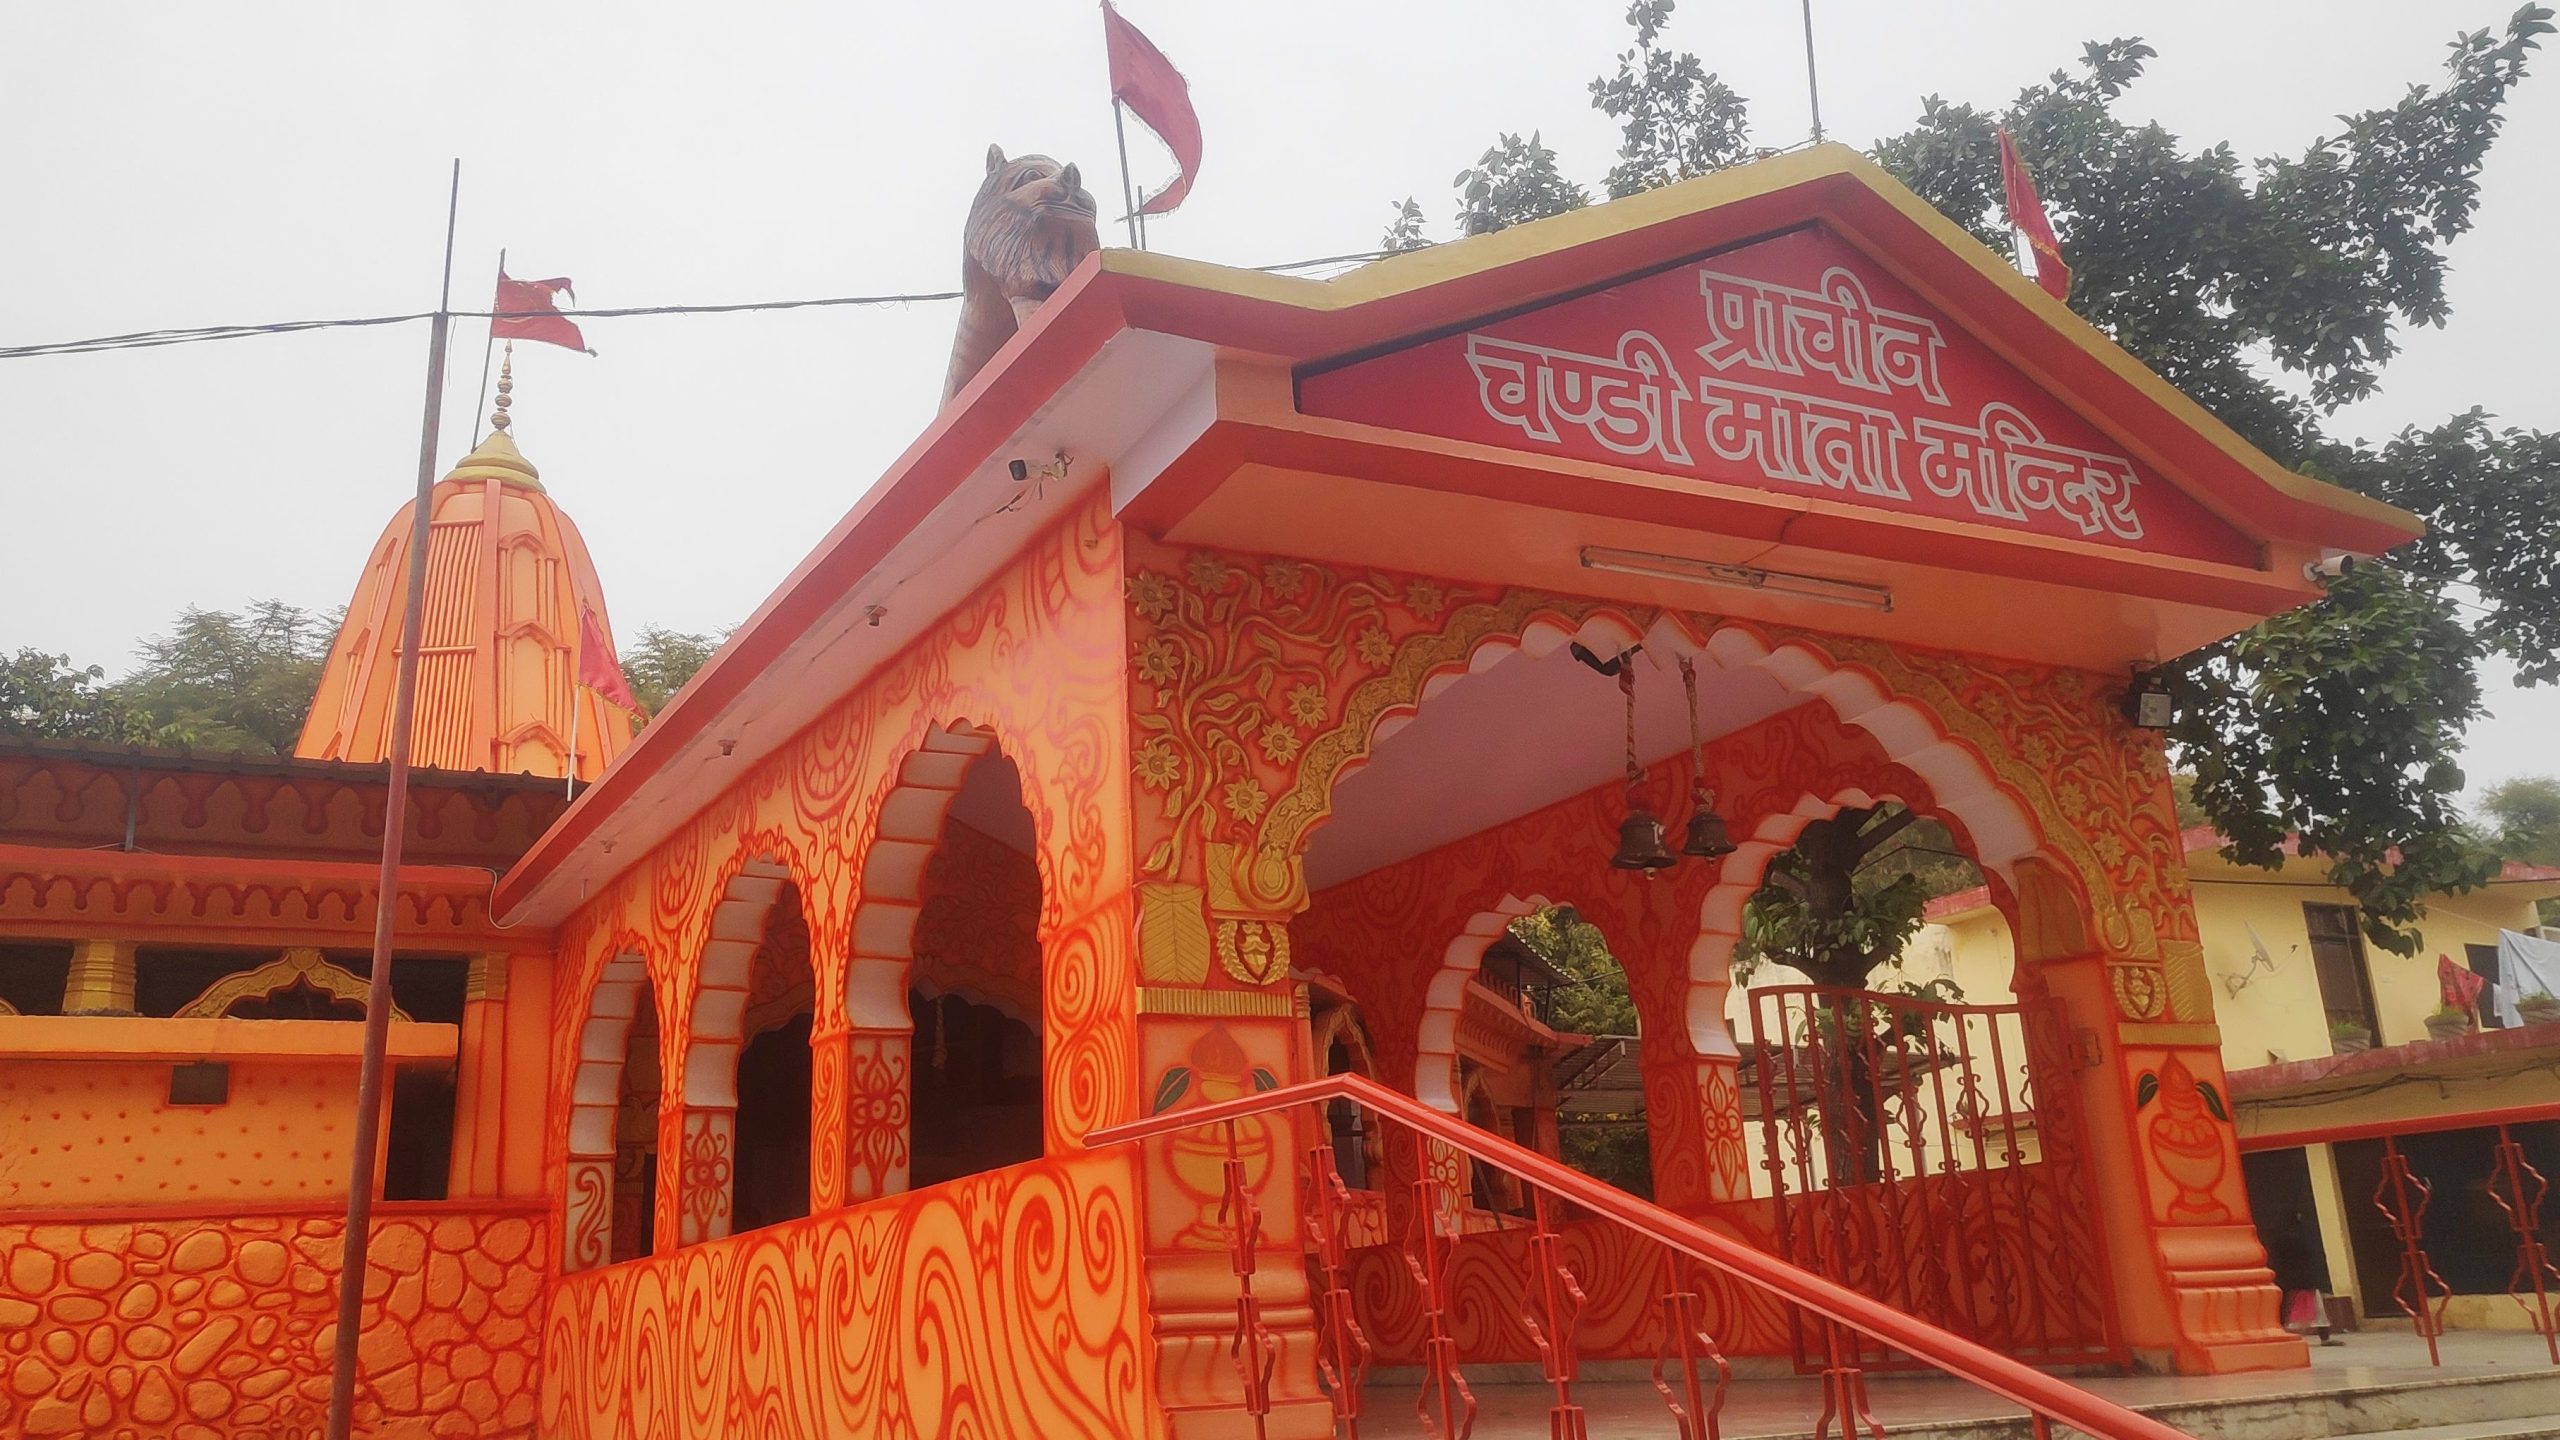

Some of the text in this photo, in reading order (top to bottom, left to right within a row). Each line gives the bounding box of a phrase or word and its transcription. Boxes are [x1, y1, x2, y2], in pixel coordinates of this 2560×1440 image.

[1696, 266, 1950, 406] प्राचीन
[1464, 330, 2144, 540] चण्डी माता मन्दिर
